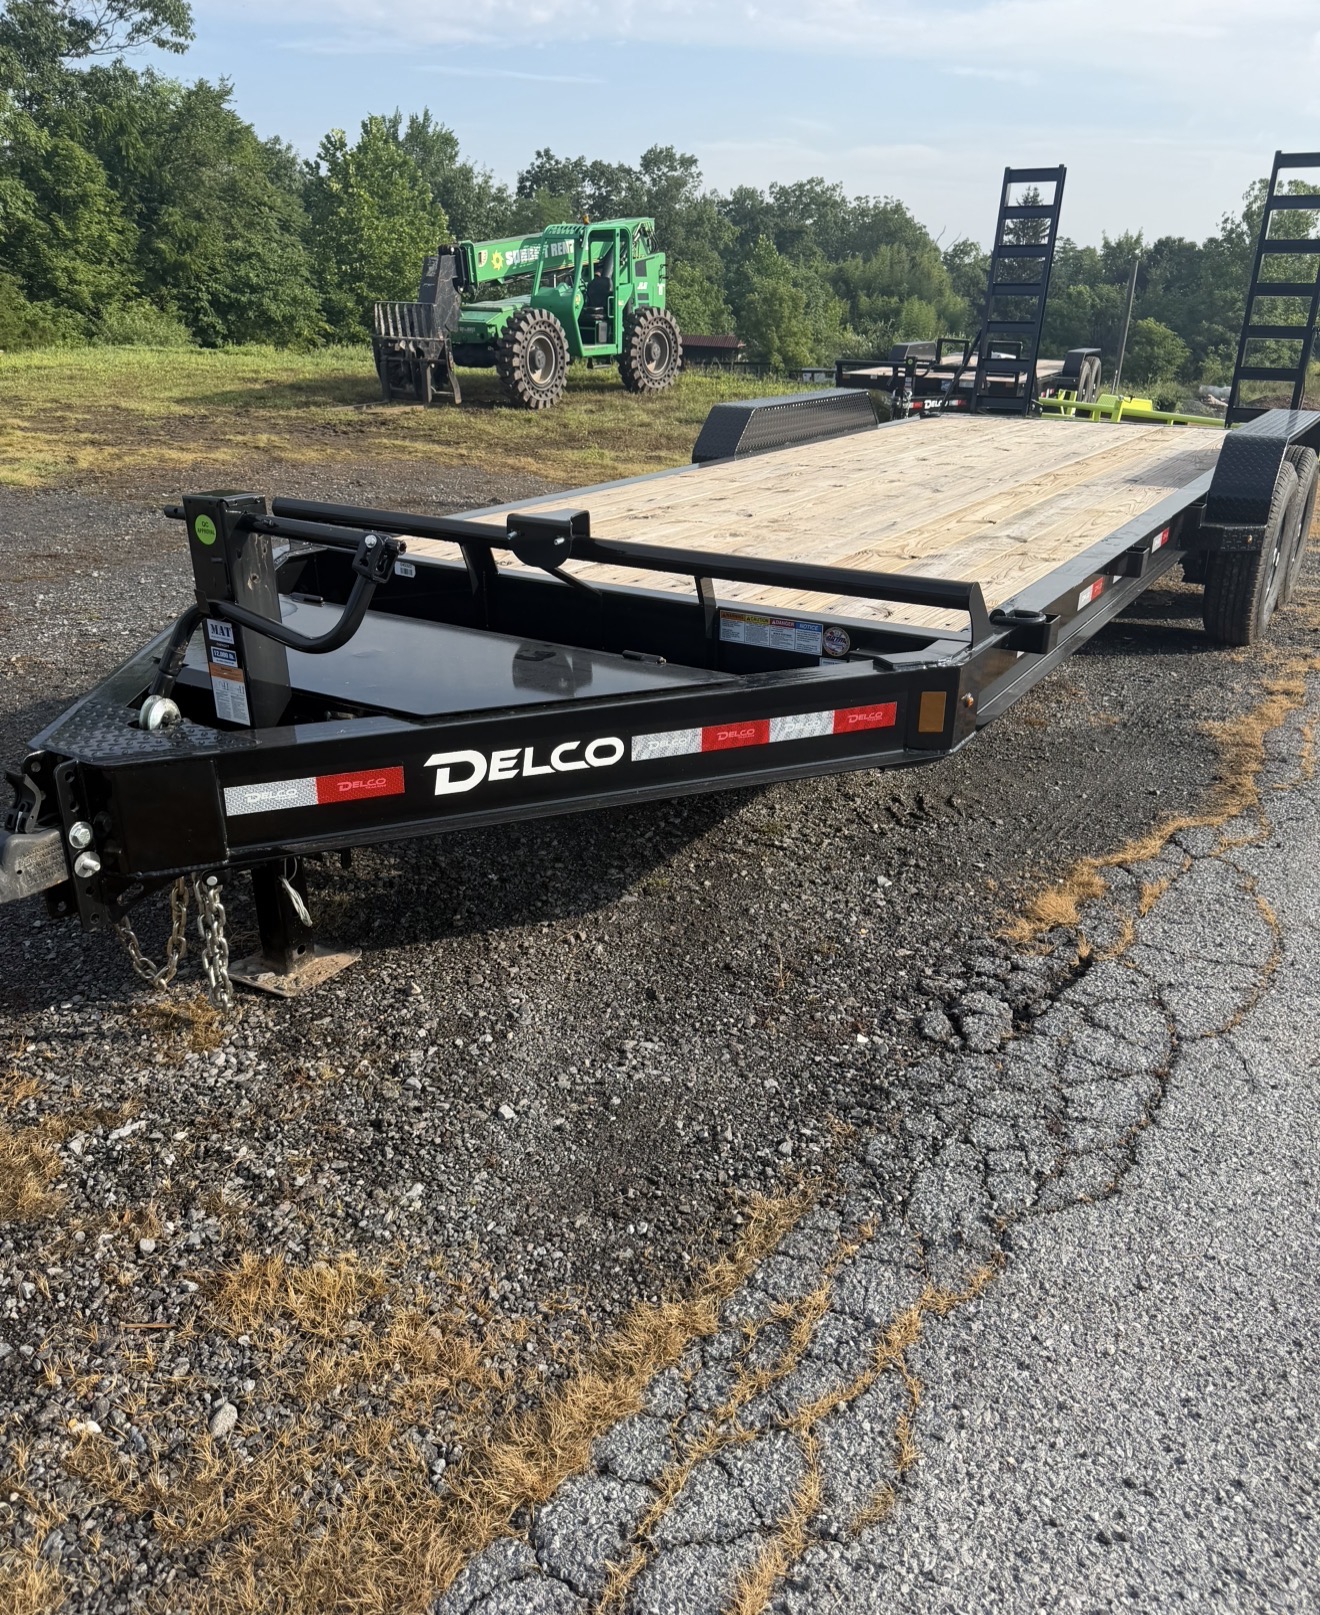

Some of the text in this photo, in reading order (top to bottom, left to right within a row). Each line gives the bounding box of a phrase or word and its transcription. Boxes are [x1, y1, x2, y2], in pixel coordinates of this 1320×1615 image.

[505, 244, 549, 266] SUNBET
[210, 623, 231, 638] MAT
[799, 623, 819, 631] NOTICE
[847, 711, 883, 723] DELCO
[717, 728, 755, 741] DELCO
[423, 736, 625, 796] DELCO
[337, 777, 387, 792] DELCO
